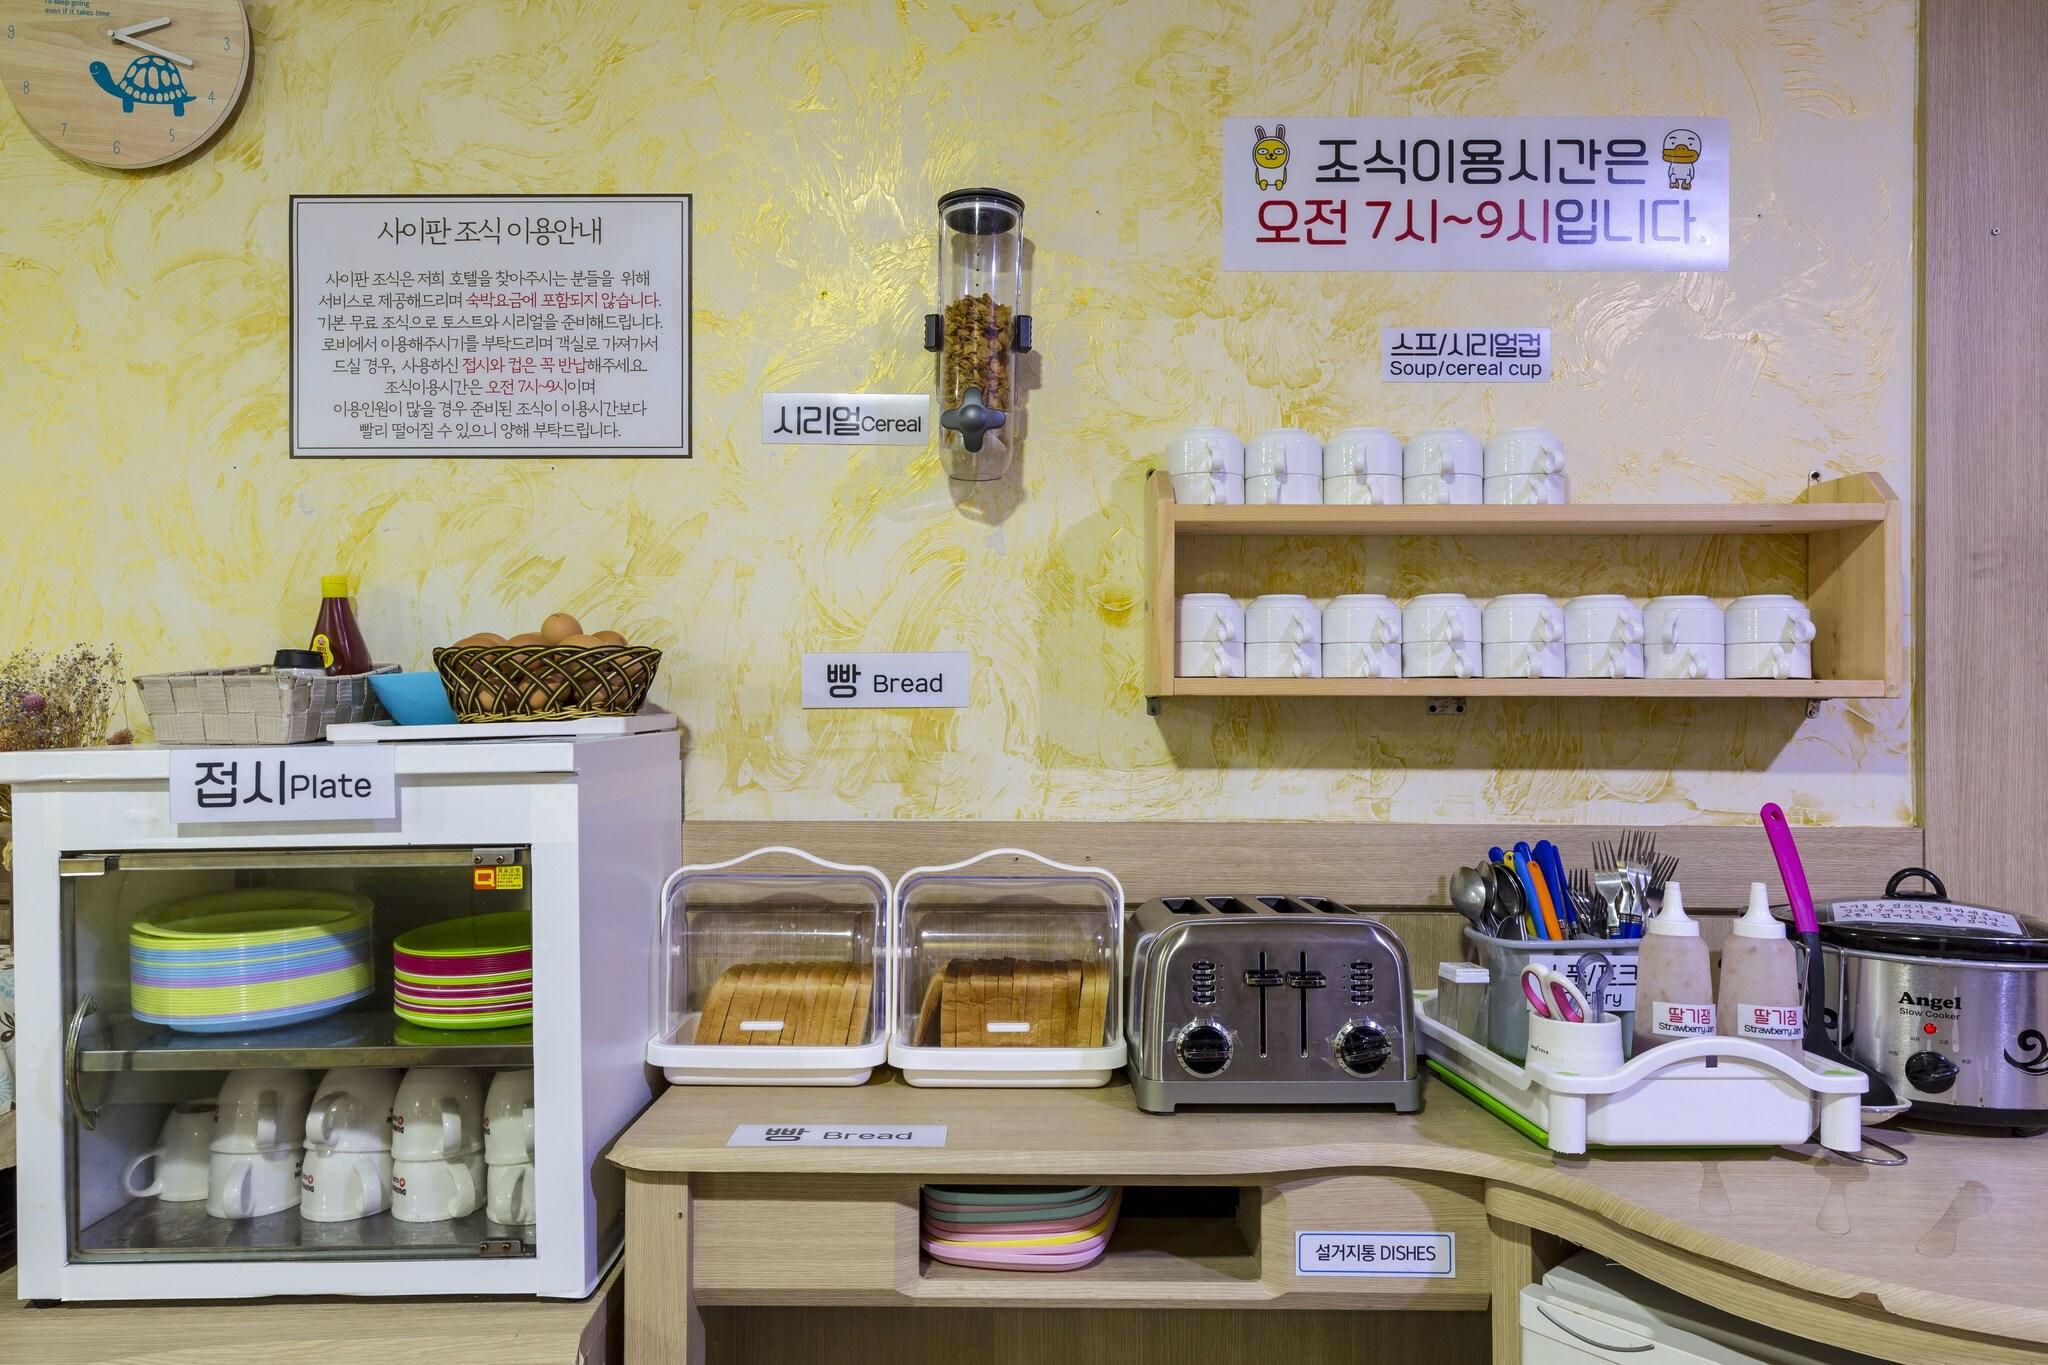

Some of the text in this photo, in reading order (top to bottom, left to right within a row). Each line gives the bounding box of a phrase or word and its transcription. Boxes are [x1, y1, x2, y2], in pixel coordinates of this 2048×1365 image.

[62, 7, 68, 15] if
[77, 8, 93, 16] takes
[95, 9, 111, 17] time
[71, 0, 90, 8] going
[7, 25, 16, 39] 9
[223, 36, 231, 51] 3
[23, 80, 30, 95] 8
[207, 91, 216, 104] 4
[61, 122, 68, 136] 7
[169, 128, 175, 142] 5
[112, 140, 121, 154] 6
[1315, 138, 1650, 186] 조식이용시간은
[1255, 198, 1347, 245] 오전
[377, 216, 603, 246] 사이판 조식 이용안내
[326, 269, 650, 287] 사이판 조식은 저희 호텔을 찾아주시는 분들을 위해
[318, 292, 662, 310] 서비스로 제공해드리며 숙박요금에 포함되지 않습니다.
[318, 314, 663, 331] 기본 무료 조식으로 토스트와 시리얼을 준비해드립니다.
[322, 335, 658, 353] 로비에서 이용해주시기를 부탁드리며 객실로 가져가서
[1390, 332, 1542, 358] 스프/시리얼컵
[333, 357, 360, 374] 드실
[365, 357, 396, 374] 경우,
[402, 357, 458, 374] 사용하신
[462, 357, 505, 374] 접시와
[508, 357, 537, 374] 컵은
[540, 357, 555, 374] 꼭
[1390, 360, 1543, 379] Soup/cereal cup
[384, 378, 596, 396] 조식이용시간은 오전 7시~9시이며
[333, 400, 647, 418] 이용인원이 많을 경우 준비된 조식이 이용시간보다
[360, 422, 621, 440] 빨리 떨어질 수 있으니 양해 부탁드립니다.
[826, 663, 943, 699] 빵 Bread
[1898, 991, 1962, 1010] Angel
[1668, 1007, 1711, 1025] 딸기잼
[1754, 1008, 1797, 1026] 딸기잼
[1899, 1007, 1961, 1021] Slow Cooker
[1658, 1022, 1706, 1035] Strawberry
[1743, 1024, 1792, 1037] Strawberry
[765, 1127, 913, 1142] 빵 Bread
[1315, 1244, 1436, 1262] 설거지통 DISHES
